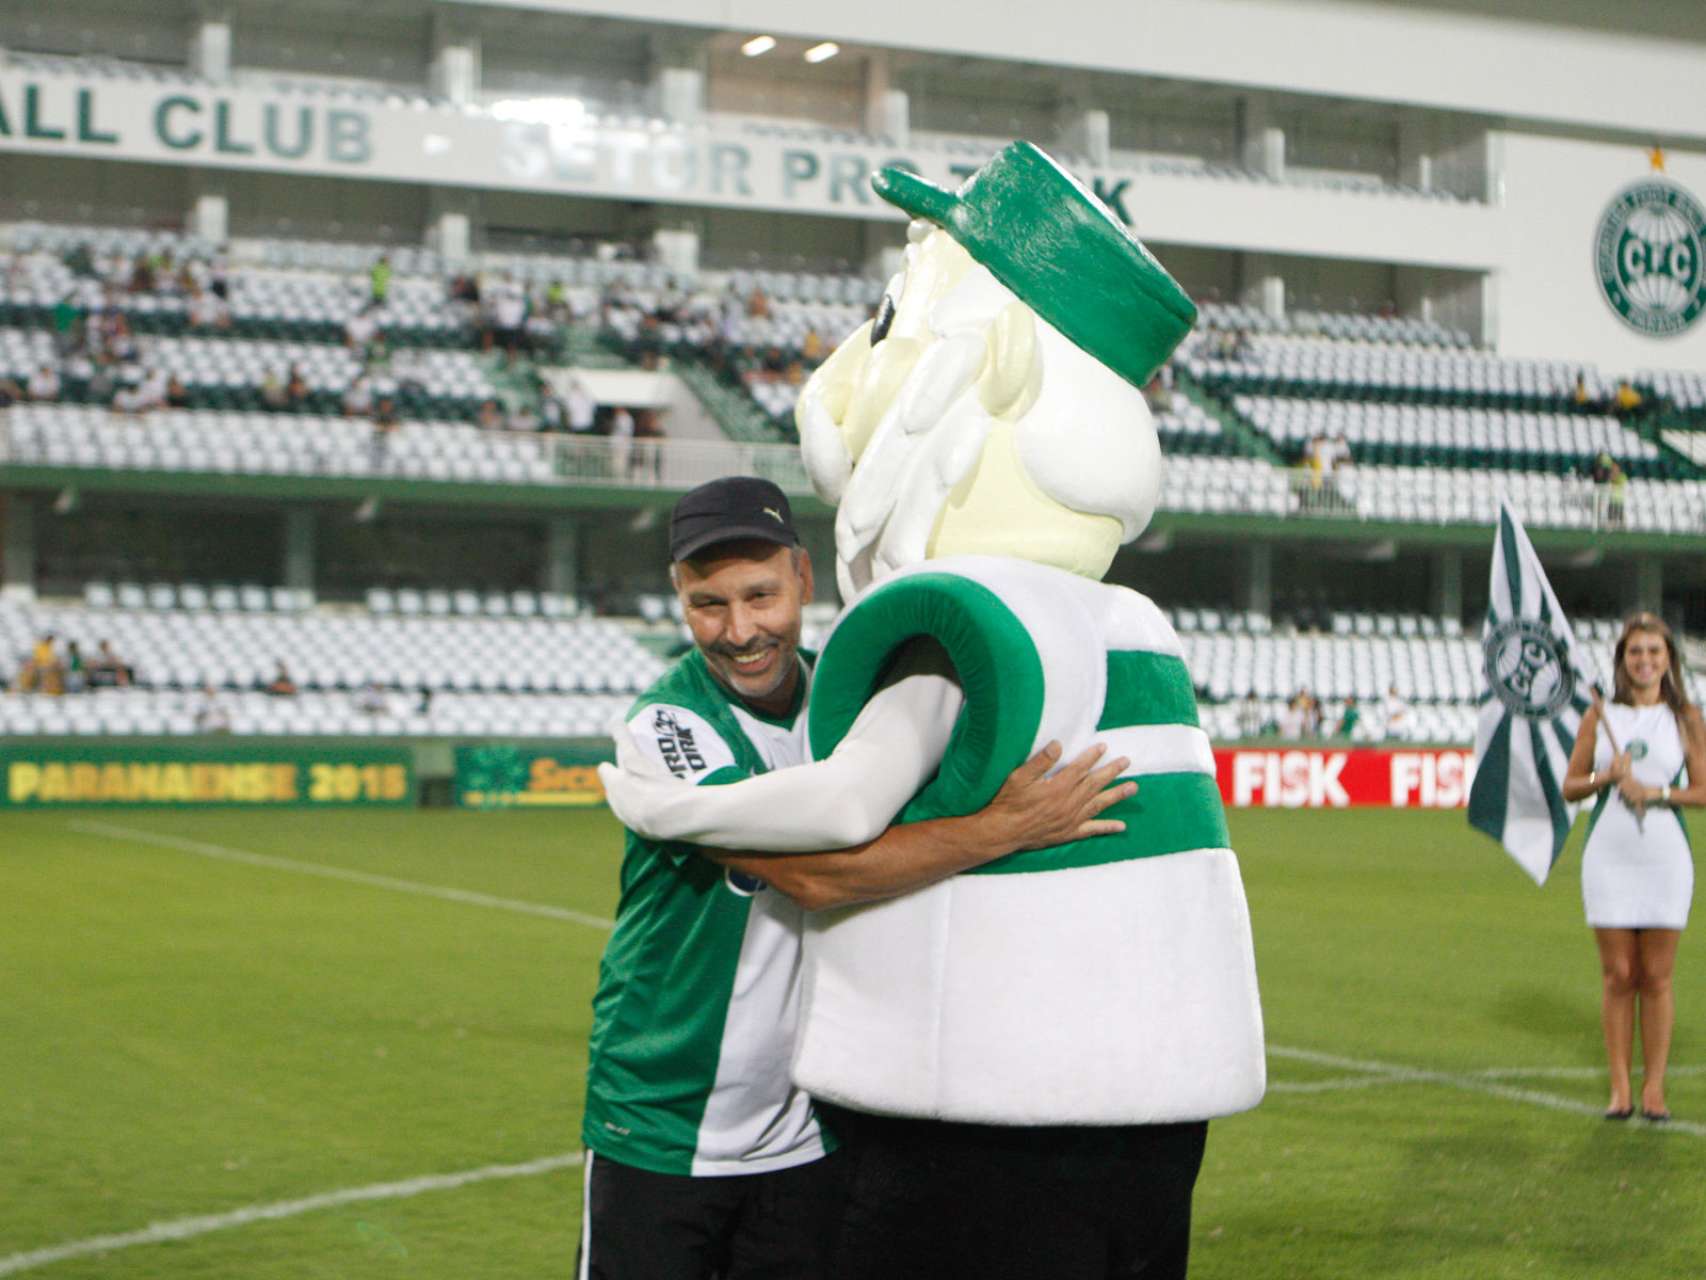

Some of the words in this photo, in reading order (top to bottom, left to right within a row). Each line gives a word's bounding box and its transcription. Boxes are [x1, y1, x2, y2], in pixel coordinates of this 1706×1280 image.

[0, 84, 118, 142] LL
[154, 96, 372, 163] CLUB
[780, 148, 920, 206] PR
[1232, 751, 1350, 807] FISK
